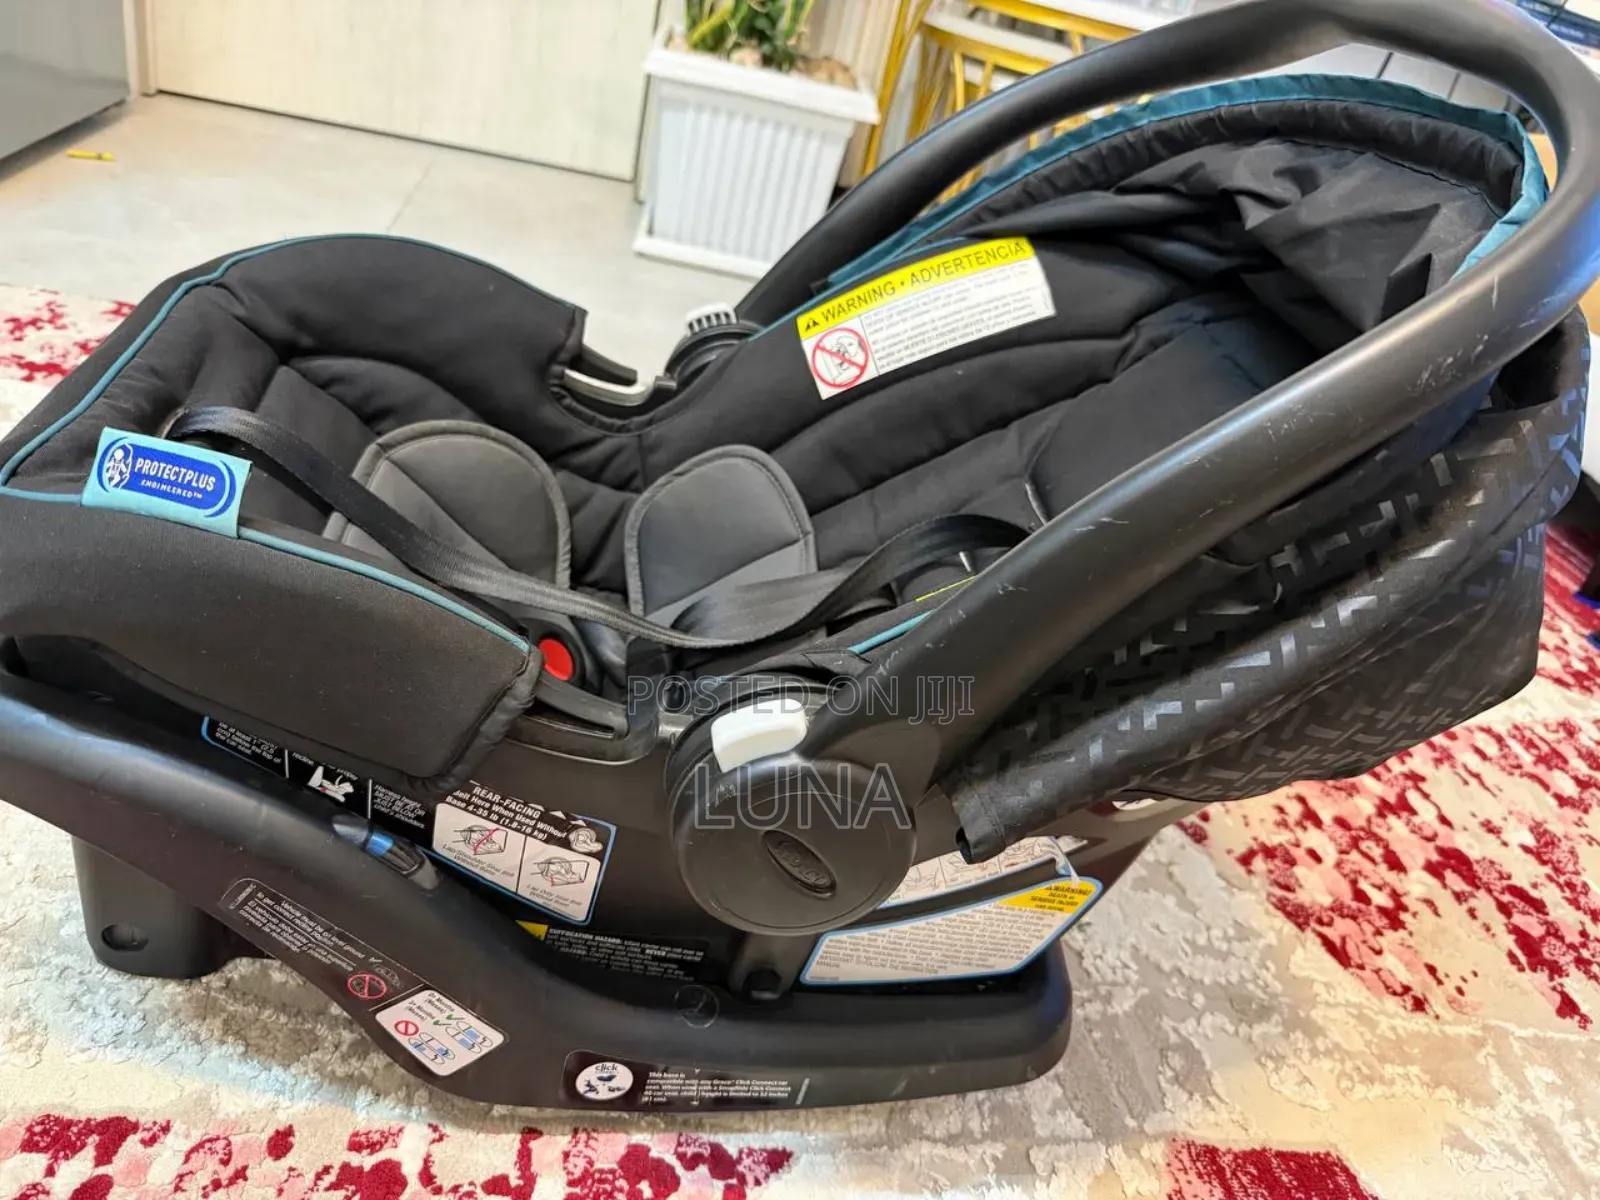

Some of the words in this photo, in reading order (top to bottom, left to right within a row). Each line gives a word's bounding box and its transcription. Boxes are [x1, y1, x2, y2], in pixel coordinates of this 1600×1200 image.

[820, 281, 896, 322] WARNING
[910, 241, 1027, 287] ADVERTENCIA
[134, 457, 217, 492] PROTECTPLUS
[446, 796, 466, 808] Base
[468, 805, 488, 816] 4-35
[533, 830, 547, 840] kg)
[471, 796, 490, 808] Here
[492, 804, 514, 818] When
[516, 814, 536, 826] Used
[537, 822, 566, 838] Without
[473, 787, 540, 818] REAR-FACING
[594, 1062, 618, 1072] click
